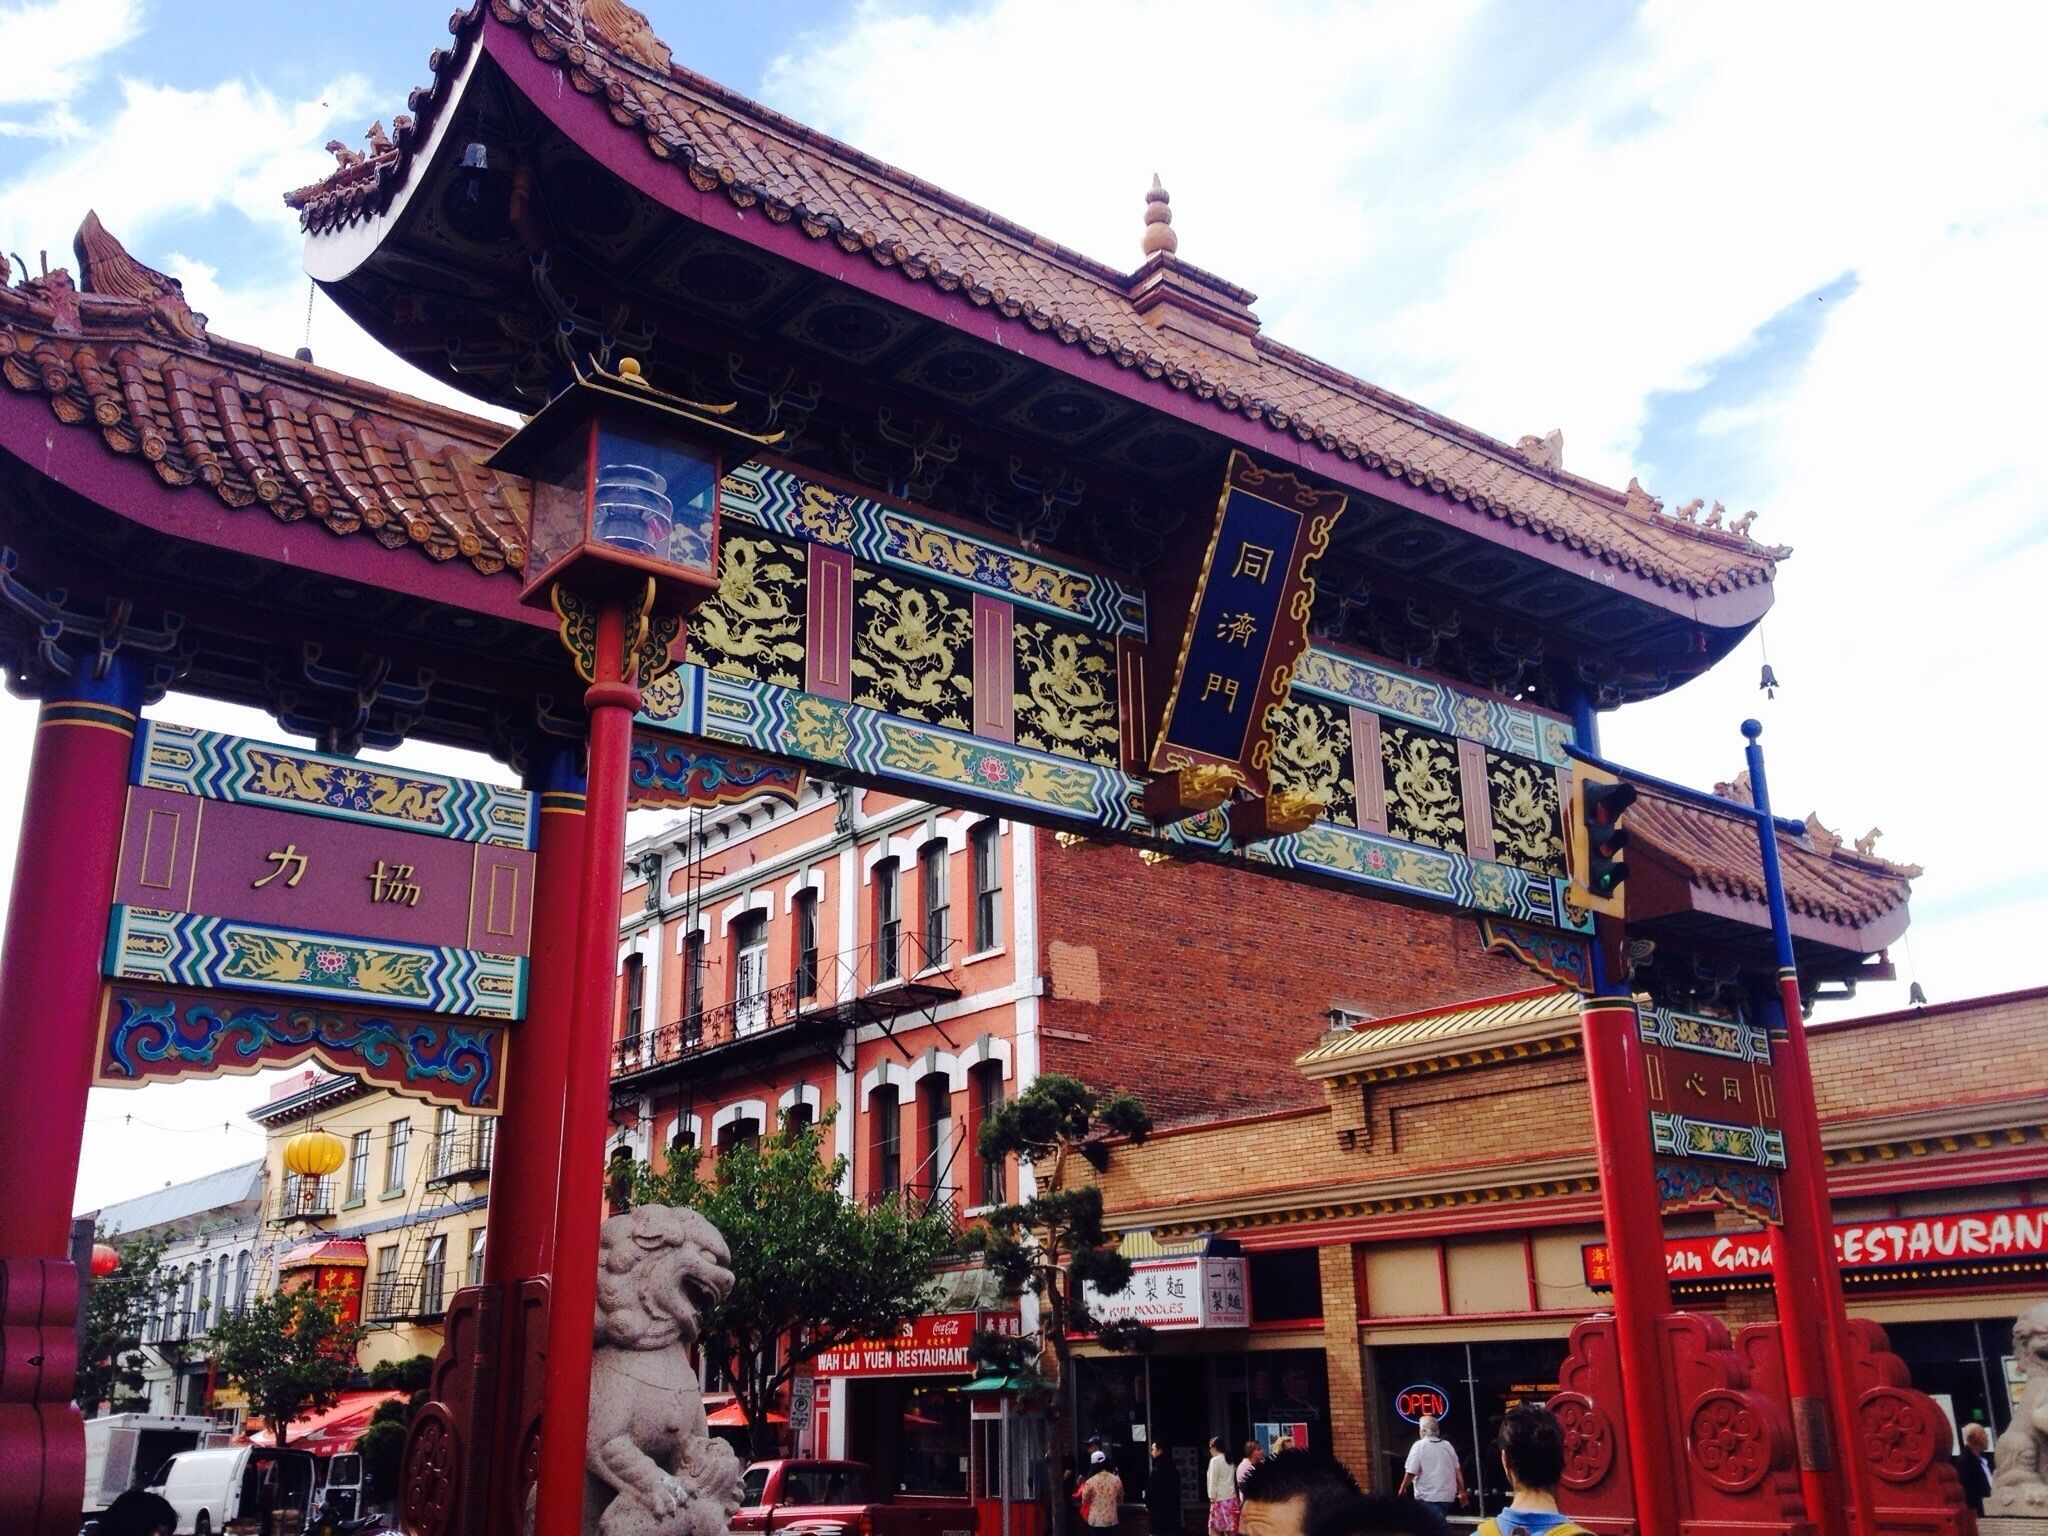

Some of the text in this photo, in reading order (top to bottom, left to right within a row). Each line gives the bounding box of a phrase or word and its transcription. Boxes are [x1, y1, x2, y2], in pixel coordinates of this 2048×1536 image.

[1200, 541, 1275, 714] 同濟門
[1134, 1302, 1184, 1316] NOODLES
[817, 1347, 969, 1371] WAH LAI YUEN RESTAURANT
[1400, 1393, 1443, 1416] OPEN
